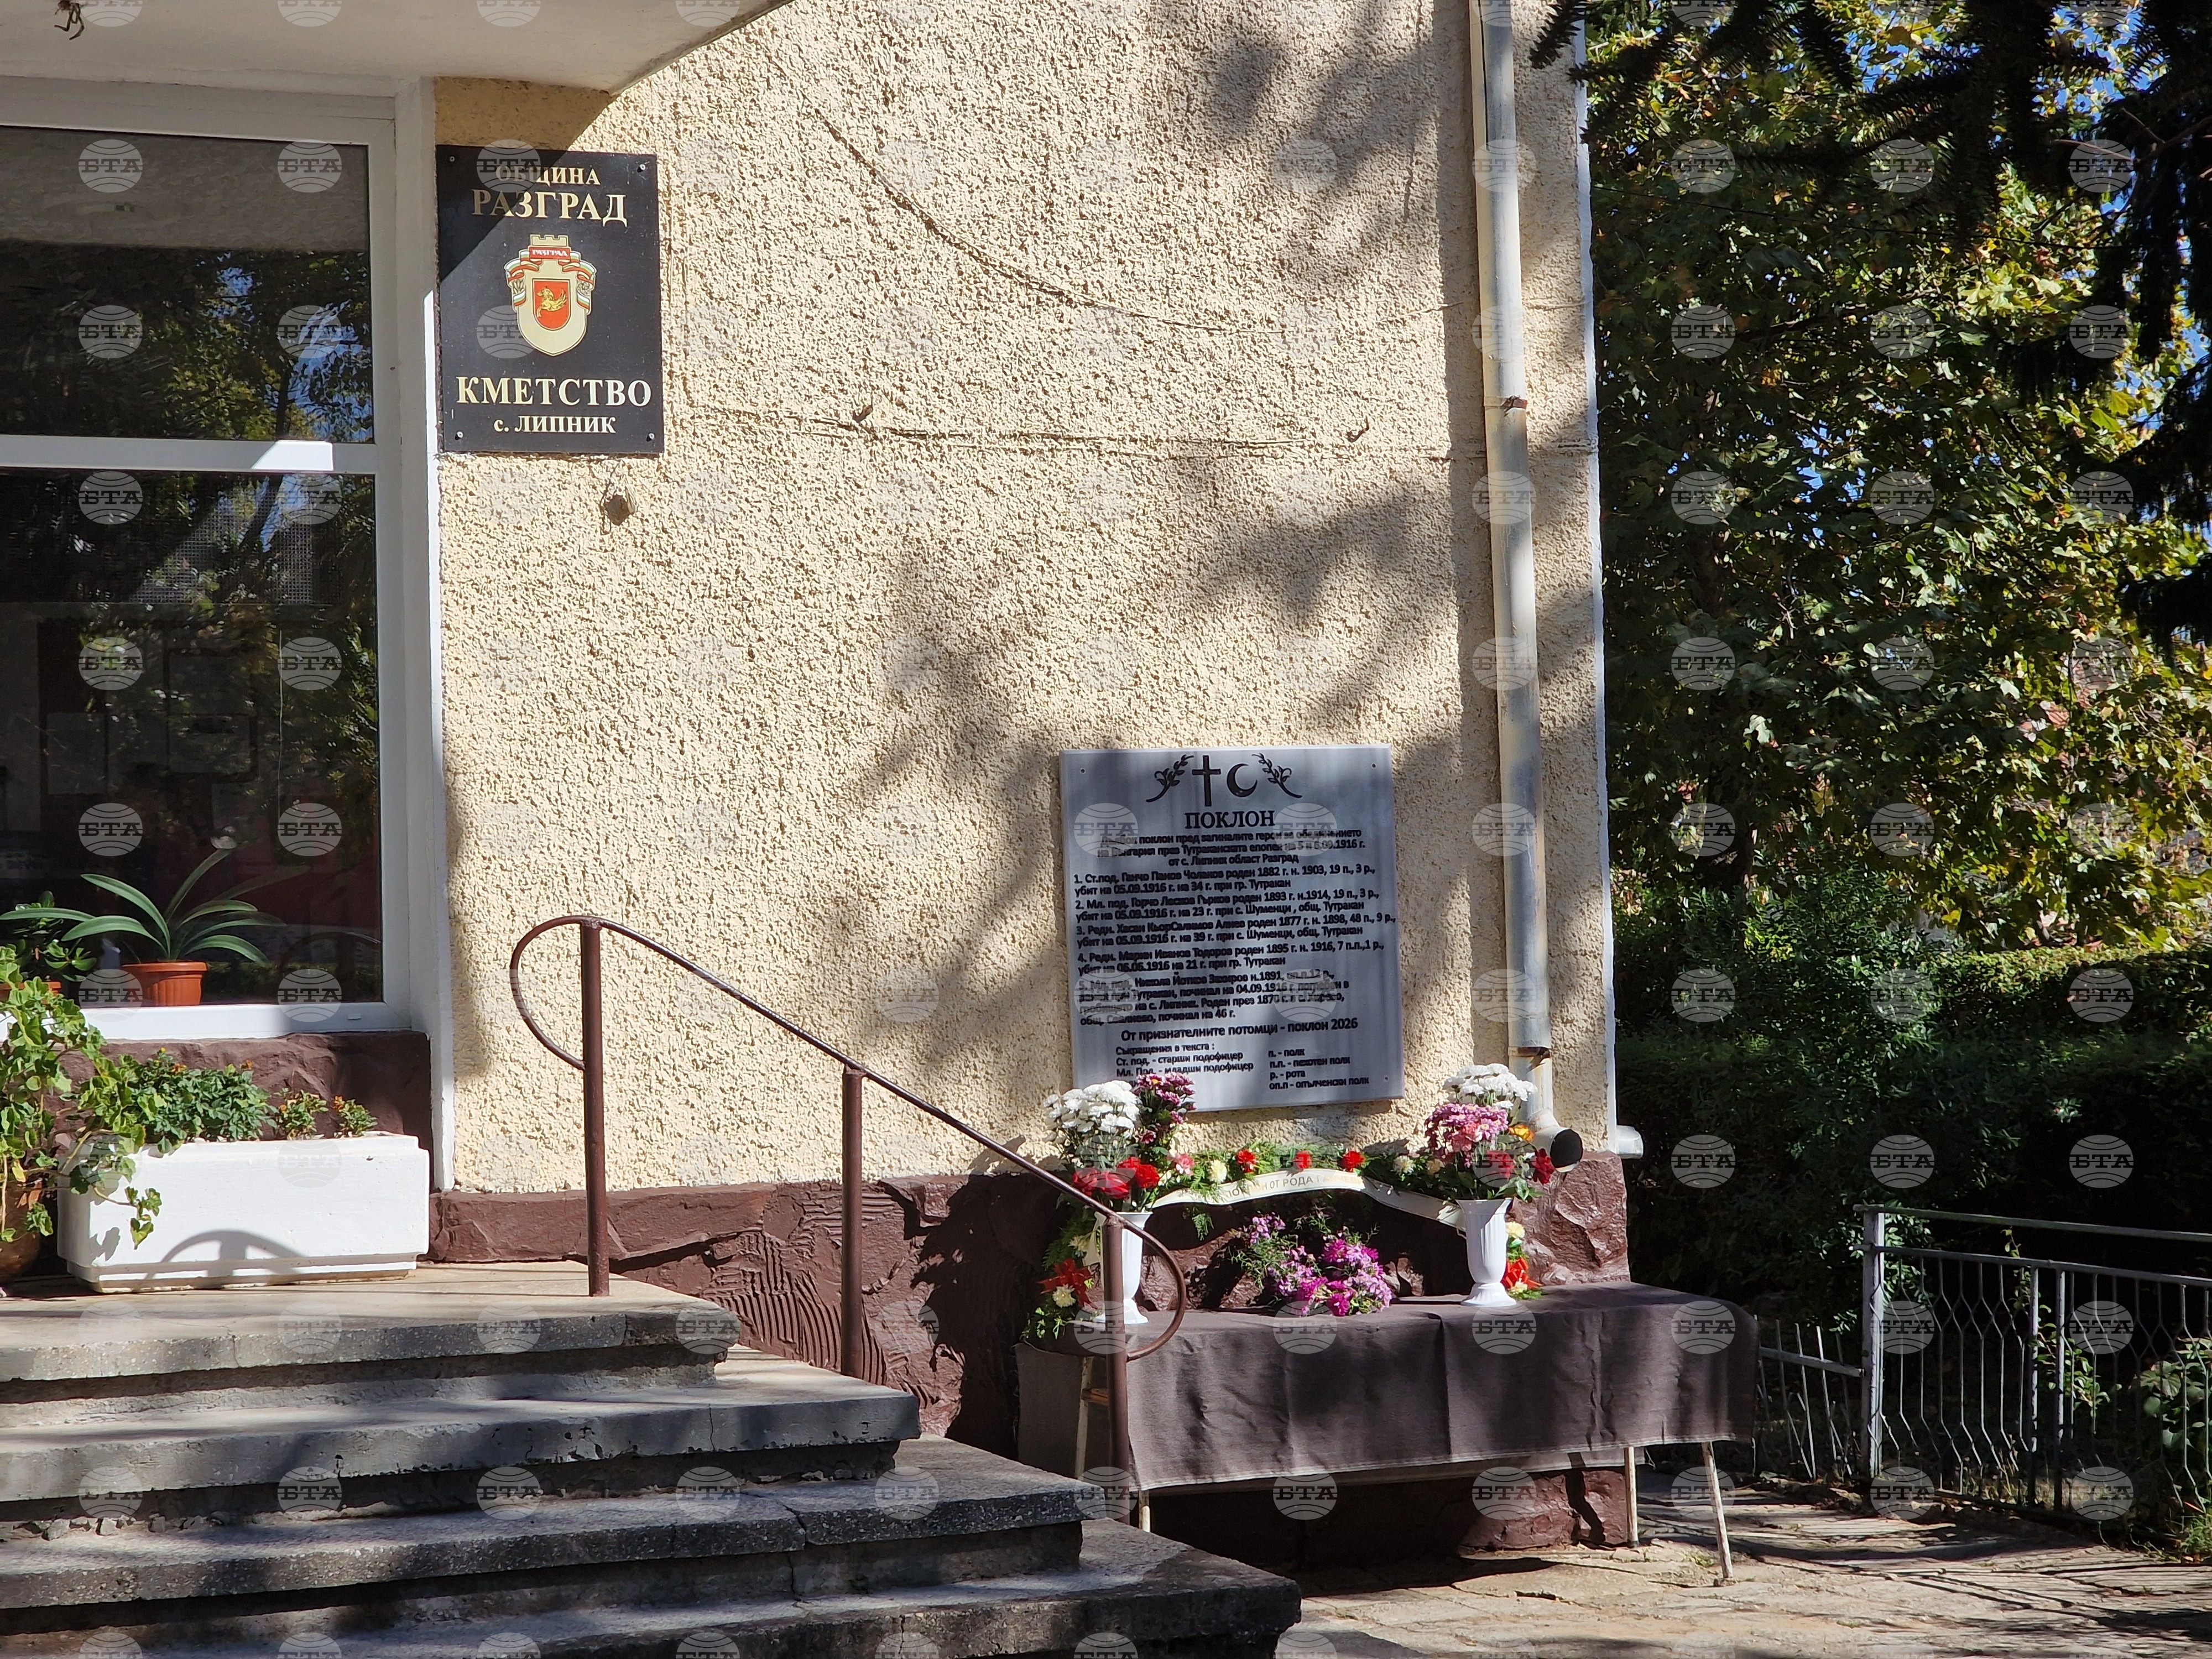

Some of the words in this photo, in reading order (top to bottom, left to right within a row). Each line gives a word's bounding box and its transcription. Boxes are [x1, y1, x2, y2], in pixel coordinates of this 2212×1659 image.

[495, 165, 601, 187] ОБЩИНА
[471, 189, 628, 227] РАЗГРАД
[456, 377, 651, 406] КМЕТСТВО
[494, 419, 509, 432] с.
[515, 416, 617, 434] ЛИПНИК
[1184, 810, 1276, 830] ПОКЛОН
[1331, 1017, 1358, 1030] 2026
[1270, 1180, 1280, 1188] ОТ
[1282, 1176, 1313, 1188] РОДА
